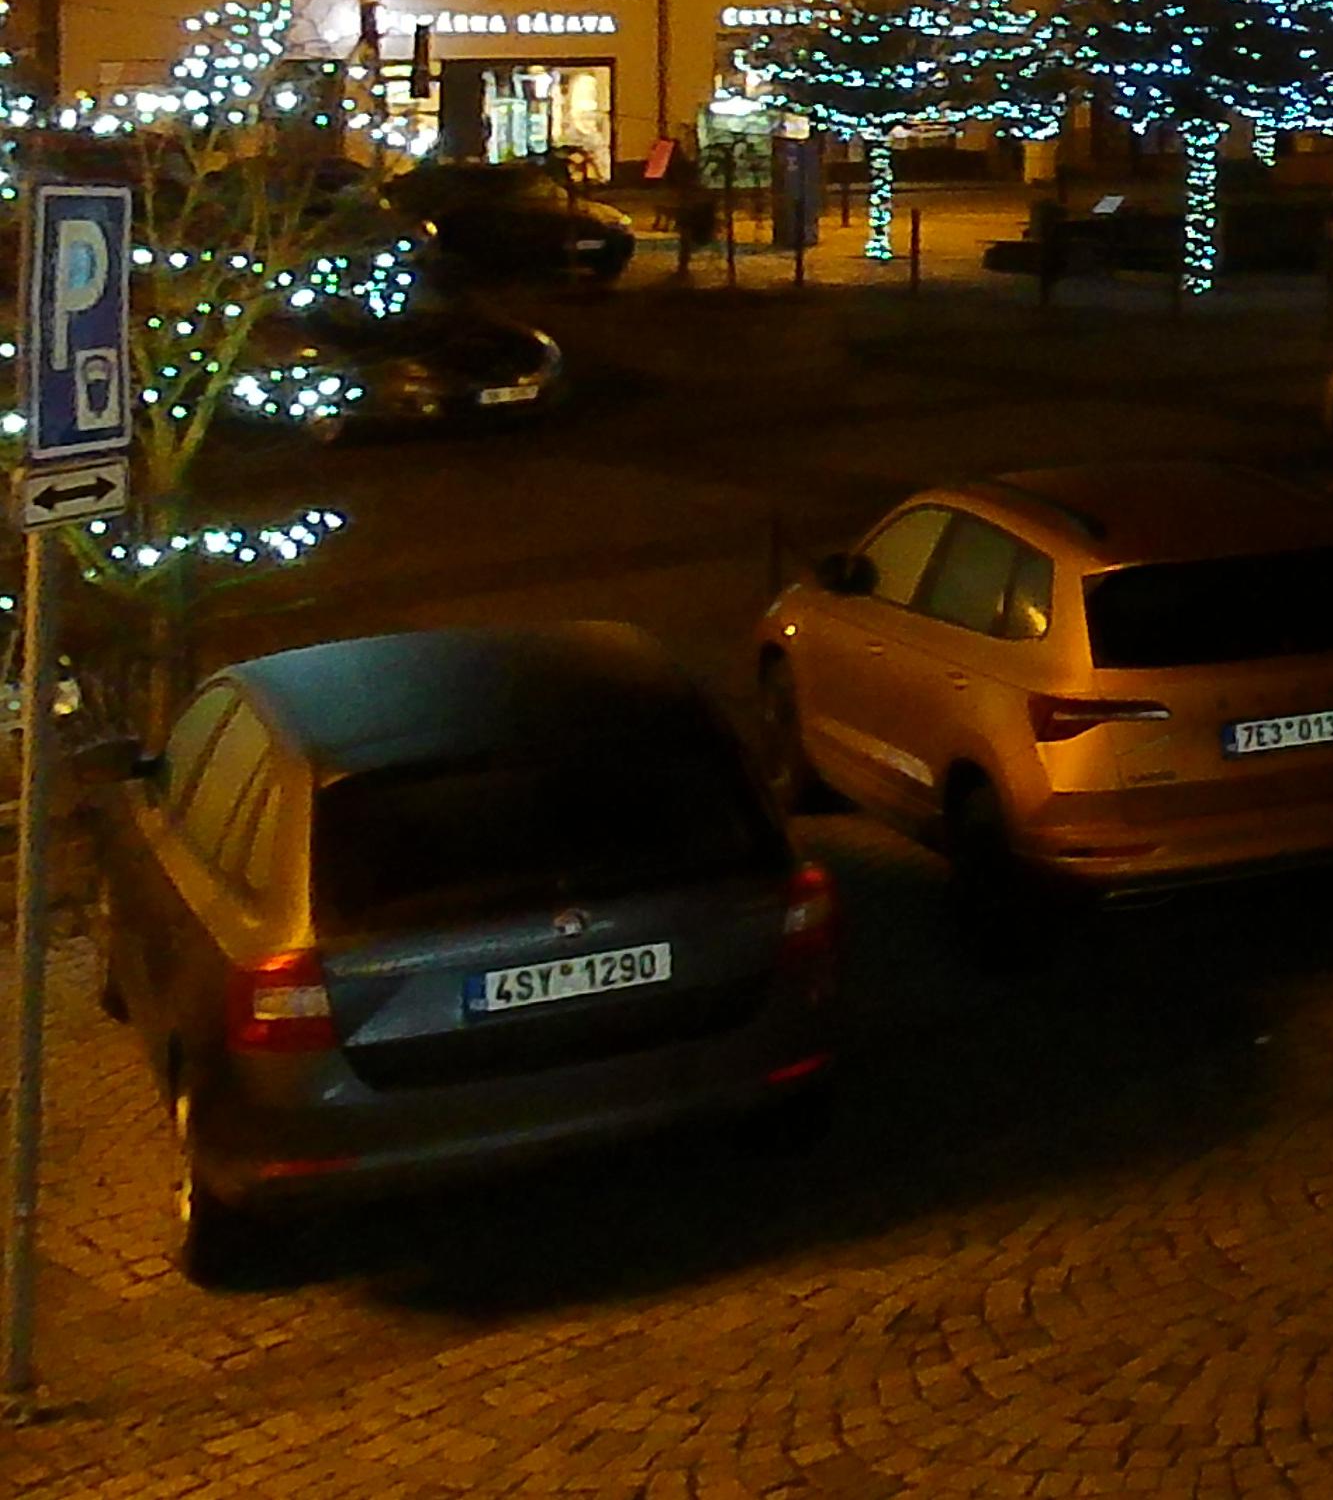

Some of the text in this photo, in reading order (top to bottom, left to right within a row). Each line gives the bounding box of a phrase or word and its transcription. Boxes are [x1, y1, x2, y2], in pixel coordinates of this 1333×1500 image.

[53, 219, 109, 371] P
[1243, 722, 1283, 749] 7E3
[496, 950, 656, 1004] 4SY 1290
